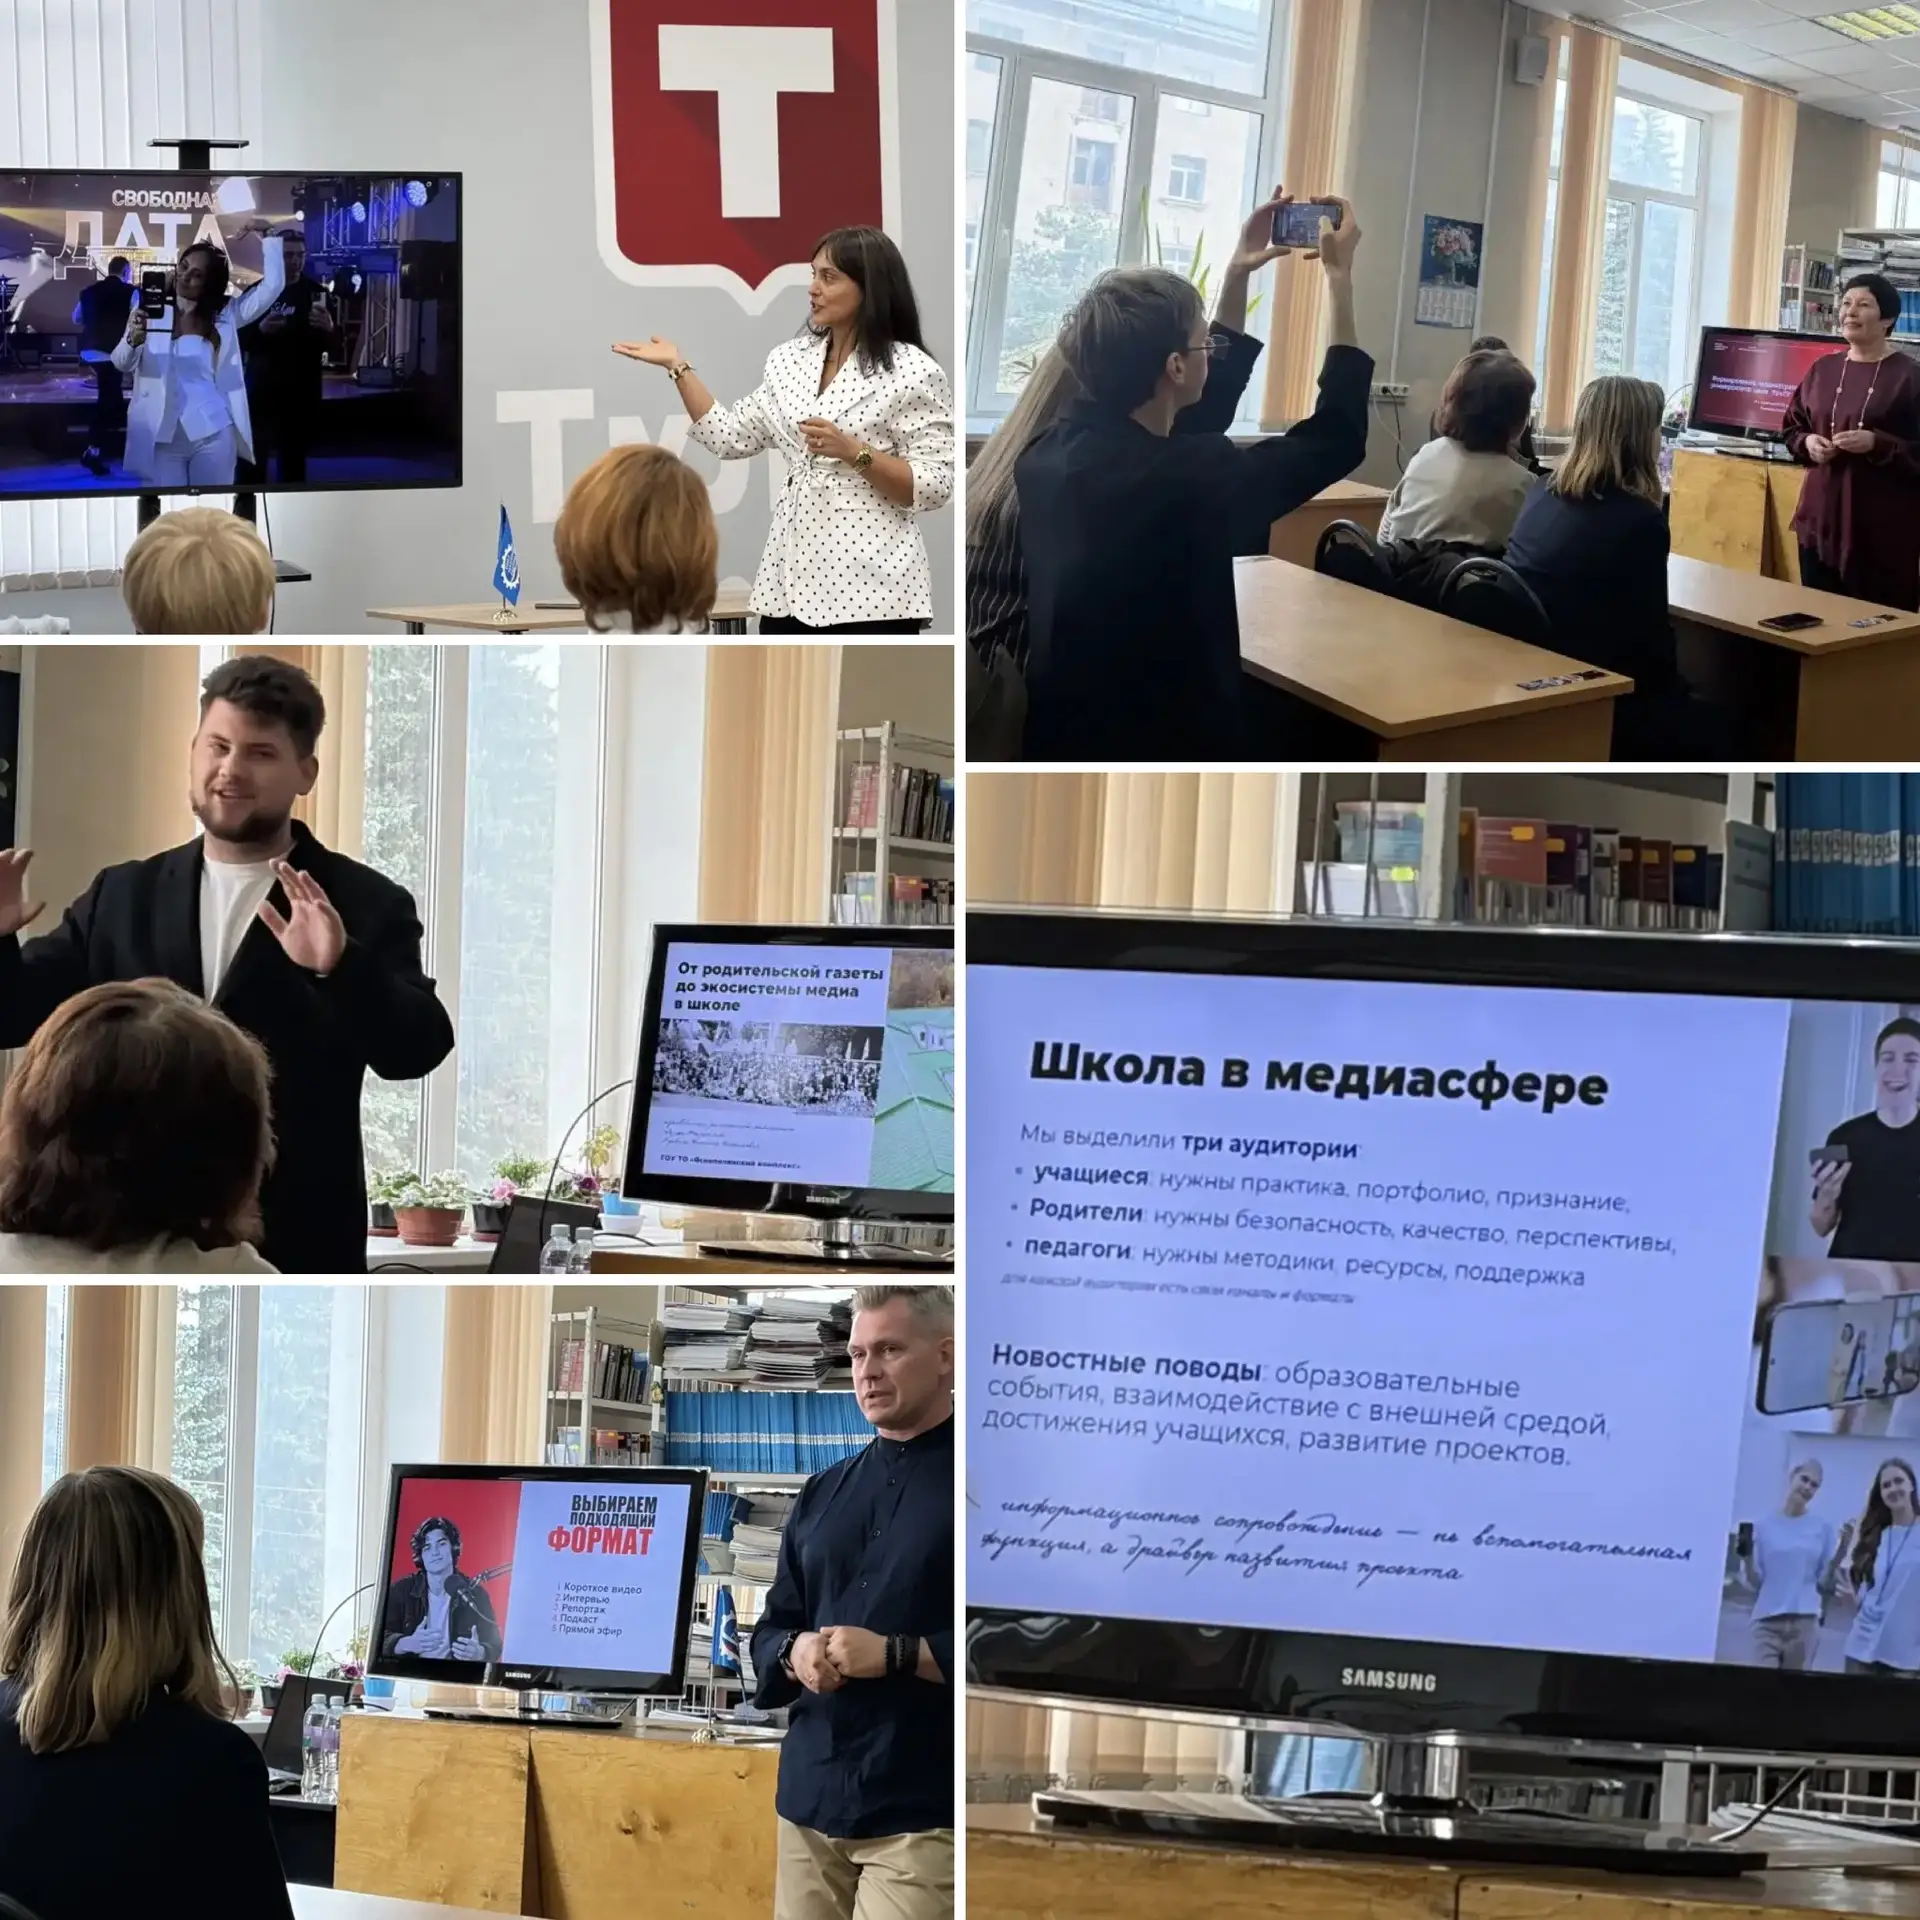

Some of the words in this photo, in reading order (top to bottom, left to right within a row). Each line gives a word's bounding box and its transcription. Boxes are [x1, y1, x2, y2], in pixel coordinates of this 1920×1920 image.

[677, 961, 698, 975] От
[701, 963, 821, 979] родительской
[825, 967, 884, 980] газеты
[675, 981, 696, 993] до
[700, 983, 801, 997] экосистемы
[805, 985, 859, 998] медиа
[674, 999, 683, 1009] в
[687, 999, 741, 1011] школе
[1030, 1040, 1205, 1088] Школа
[1221, 1058, 1250, 1088] в
[1264, 1059, 1609, 1113] медиасфере
[1020, 1123, 1056, 1144] Мы
[1062, 1128, 1176, 1151] выделили
[1182, 1133, 1223, 1156] три
[1159, 1173, 1235, 1193] нужны
[1357, 1180, 1490, 1208] портфолио,
[1496, 1188, 1631, 1214] признание,
[1154, 1209, 1229, 1230] нужны
[1235, 1208, 1395, 1240] безопасность,
[1516, 1228, 1677, 1256] перспективы,
[1142, 1245, 1219, 1267] нужны
[1345, 1257, 1448, 1283] ресурсы,
[1454, 1263, 1586, 1288] поддержка
[991, 1343, 1147, 1374] Новостные
[1275, 1360, 1521, 1399] образовательные
[987, 1375, 1105, 1405] события,
[1113, 1385, 1340, 1419] взаимодействие
[1346, 1402, 1362, 1420] с
[1369, 1403, 1495, 1430] внешней
[1504, 1412, 1612, 1440] средой,
[981, 1409, 1147, 1437] достижения
[1152, 1420, 1291, 1450] учащихся,
[1299, 1429, 1428, 1457] развитие
[1434, 1437, 1571, 1467] проектов.
[571, 1494, 658, 1514] ВЫБИРАЕМ
[547, 1525, 654, 1555] ФОРМАТ
[562, 1593, 610, 1604] Интервью
[563, 1582, 609, 1594] Короткое
[611, 1587, 642, 1595] видео
[560, 1613, 599, 1624] Подкаст
[561, 1604, 607, 1614] Репортаж
[559, 1623, 595, 1635] Прямой
[597, 1626, 623, 1637] эфир
[1341, 1667, 1437, 1693] SAMSUNG
